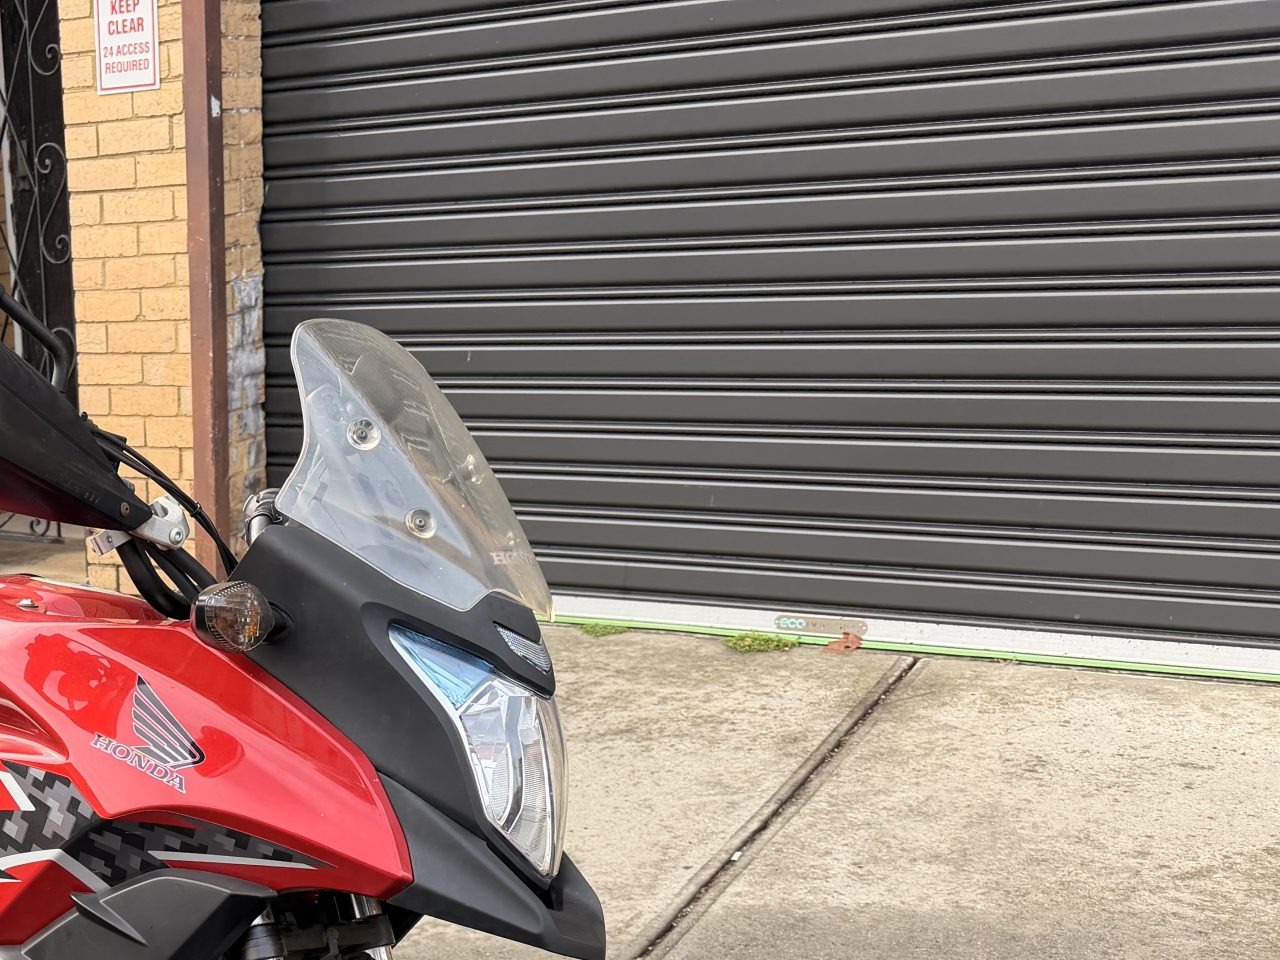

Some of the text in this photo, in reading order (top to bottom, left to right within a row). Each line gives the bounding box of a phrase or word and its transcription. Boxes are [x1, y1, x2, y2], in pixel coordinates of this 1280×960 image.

[111, 0, 140, 15] KEEP
[108, 17, 144, 35] CLEAR
[103, 41, 150, 58] 24 ACCESS
[105, 58, 150, 74] REQUIRED
[90, 732, 187, 794] HONDA
